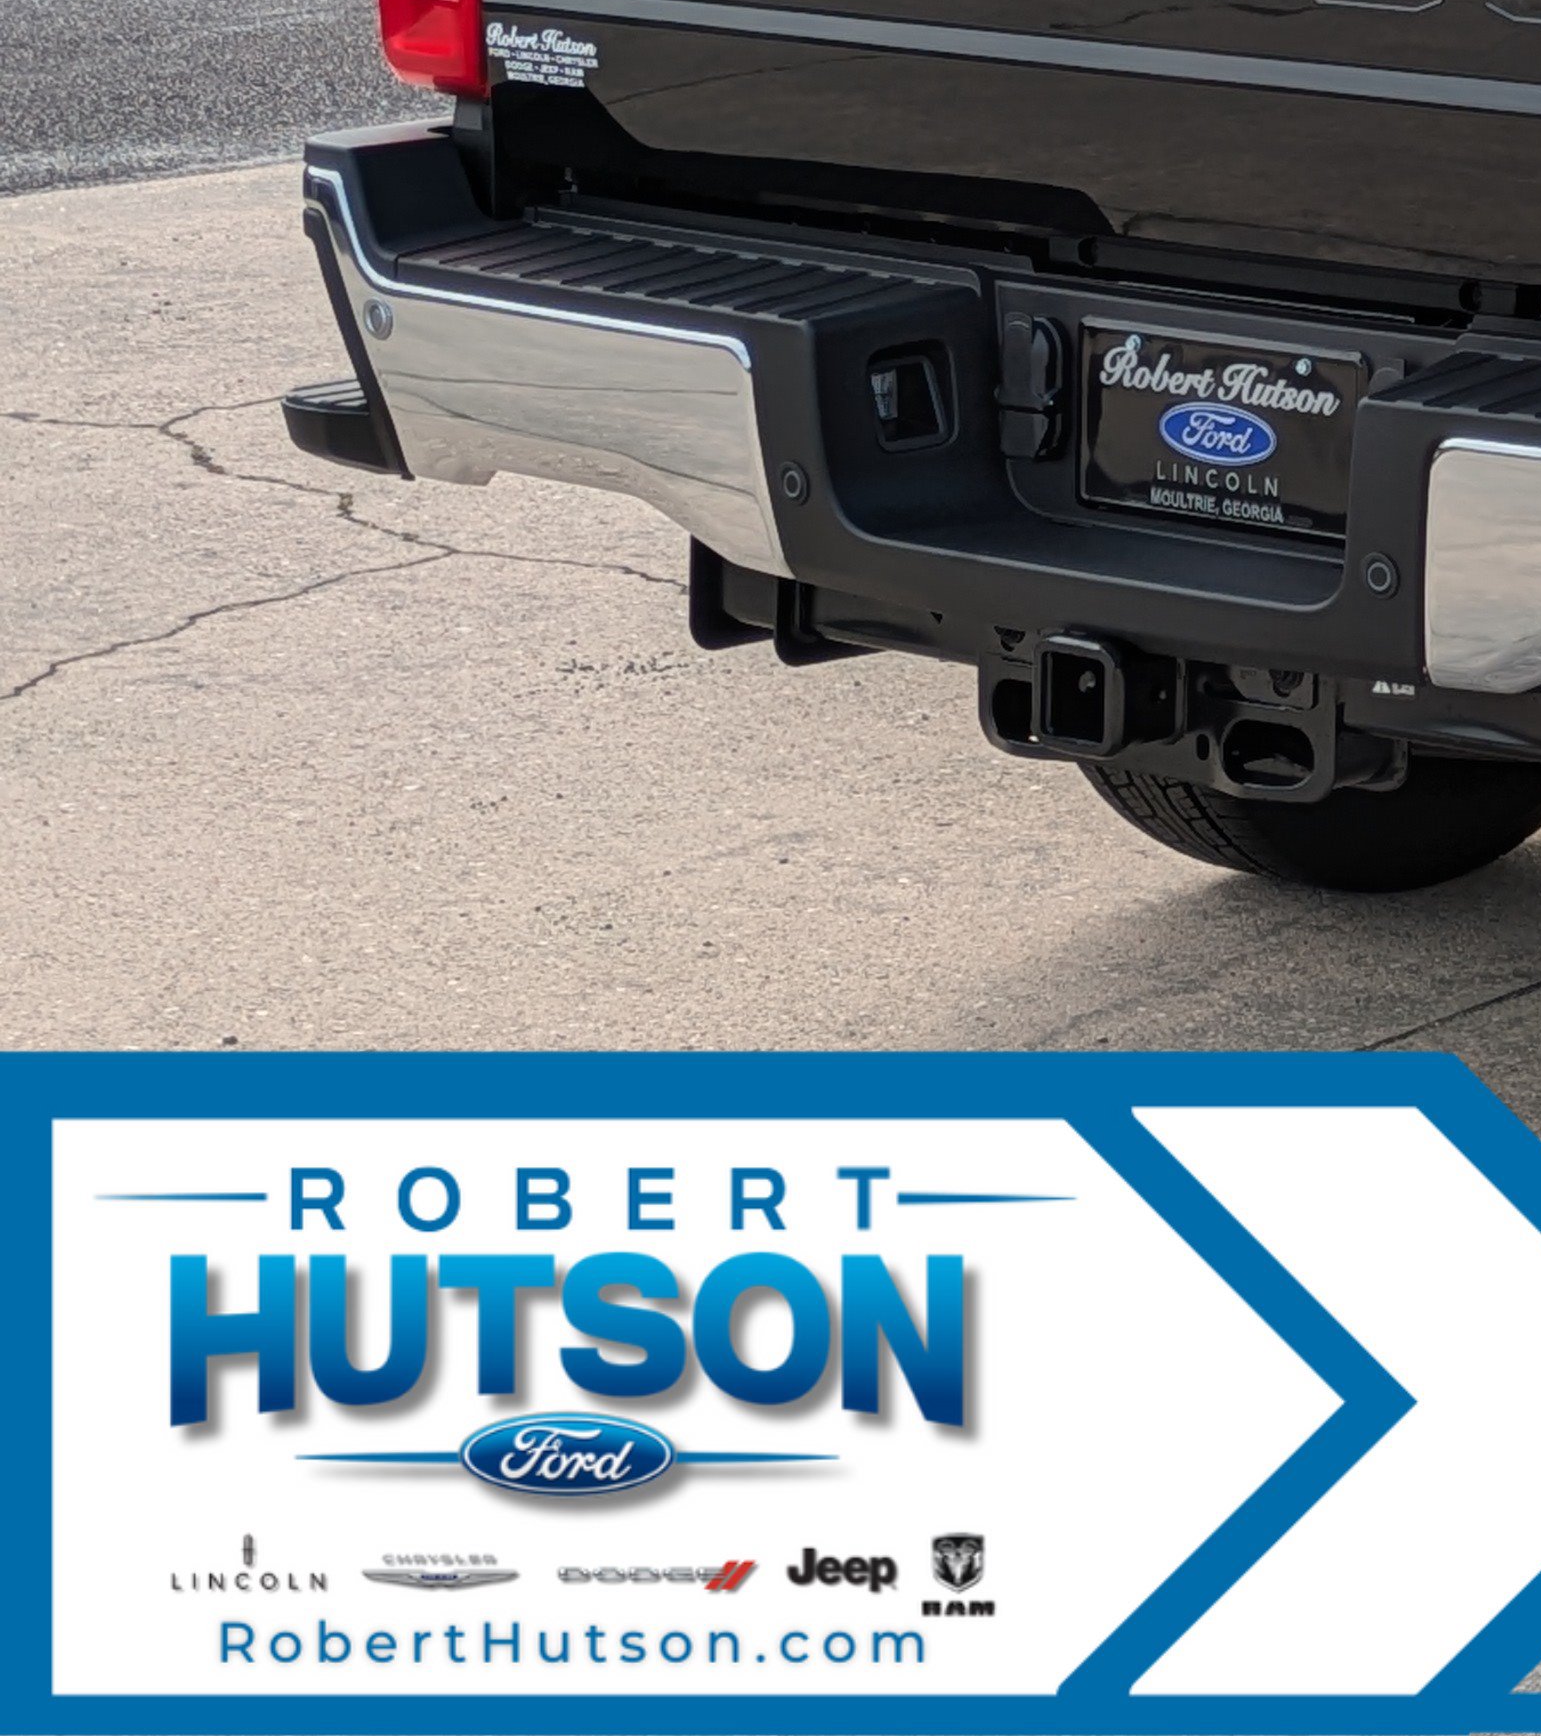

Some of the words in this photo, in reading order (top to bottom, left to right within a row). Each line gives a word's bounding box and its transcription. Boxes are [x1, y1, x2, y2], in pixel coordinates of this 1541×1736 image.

[486, 22, 540, 50] Robert
[541, 28, 598, 57] Hutson
[1099, 344, 1215, 400] Robert
[1218, 362, 1341, 417] Hutson
[1181, 411, 1253, 455] Ford
[1155, 460, 1279, 498] LINCOLN
[1150, 487, 1219, 515] MOULTRIE,
[1222, 497, 1284, 524] GEORGIA
